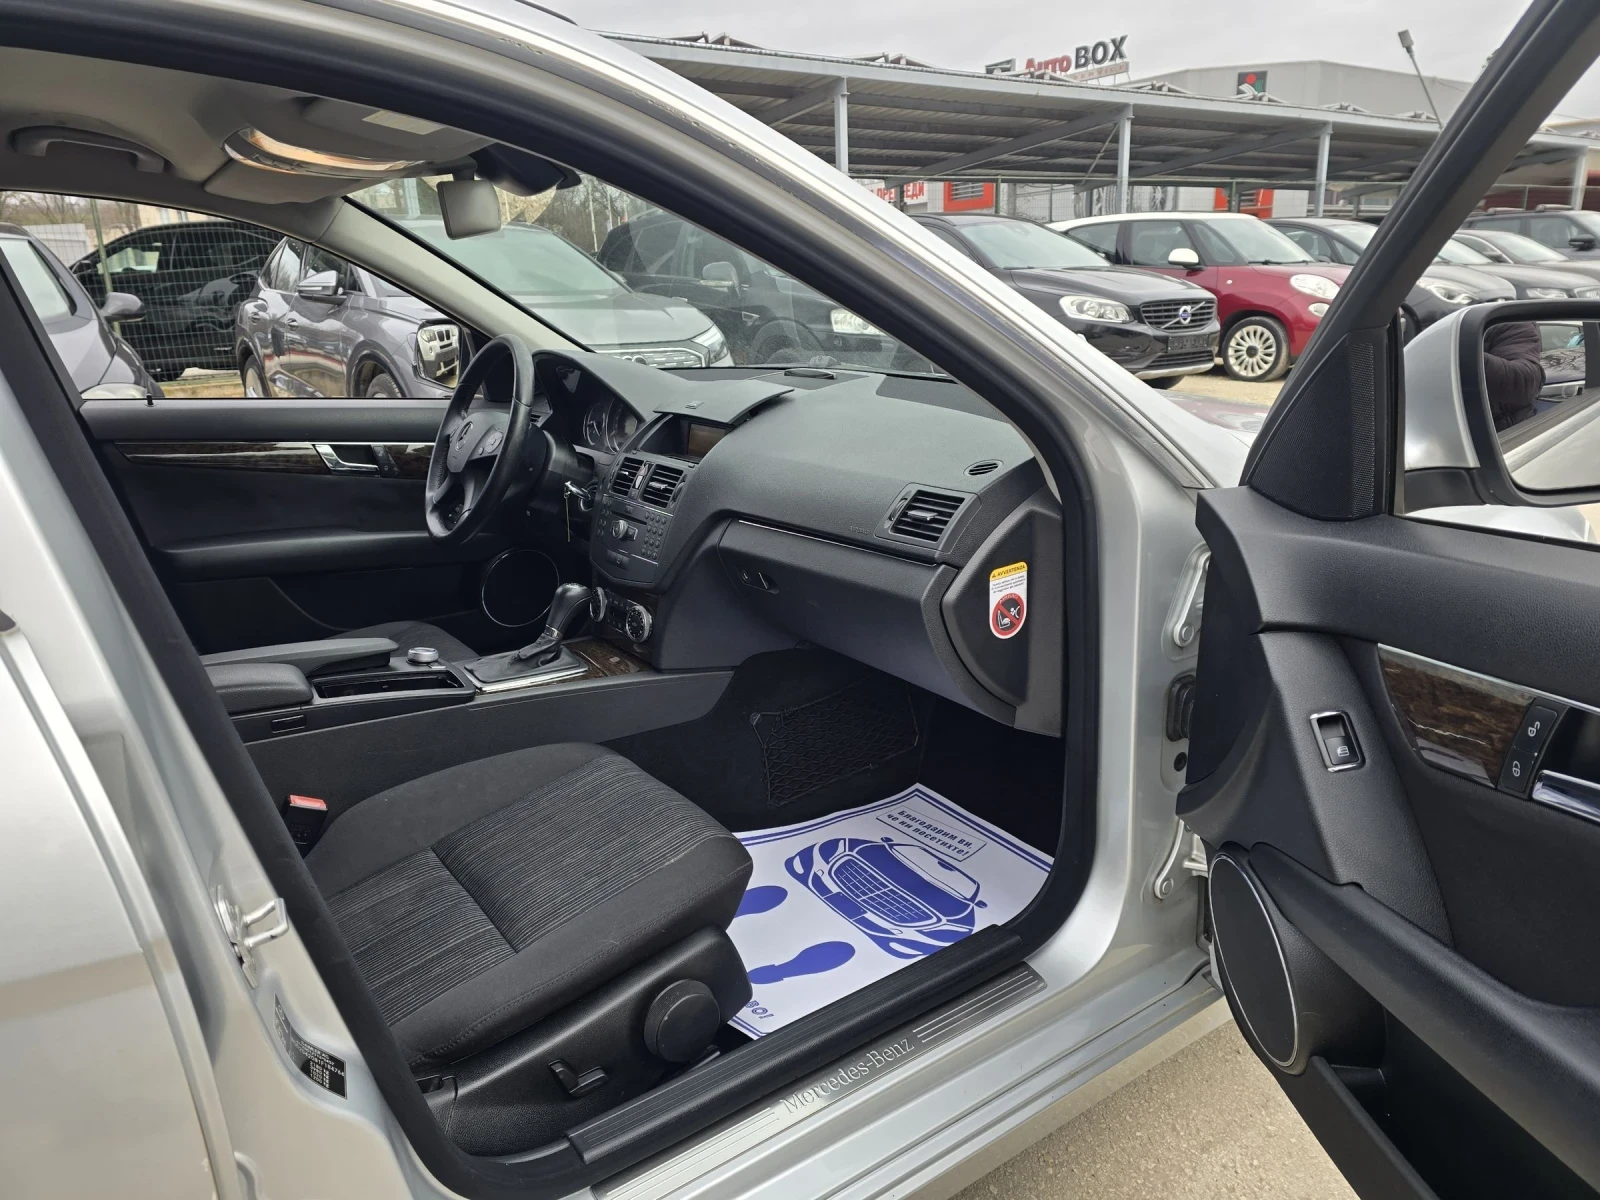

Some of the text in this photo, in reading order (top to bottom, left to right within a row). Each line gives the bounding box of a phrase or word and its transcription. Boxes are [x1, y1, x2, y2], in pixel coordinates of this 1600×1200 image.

[1074, 34, 1128, 69] BOX
[897, 810, 957, 841] Благодарим
[912, 827, 970, 856] посетихте!
[779, 1037, 916, 1115] Mercedes-Benz
